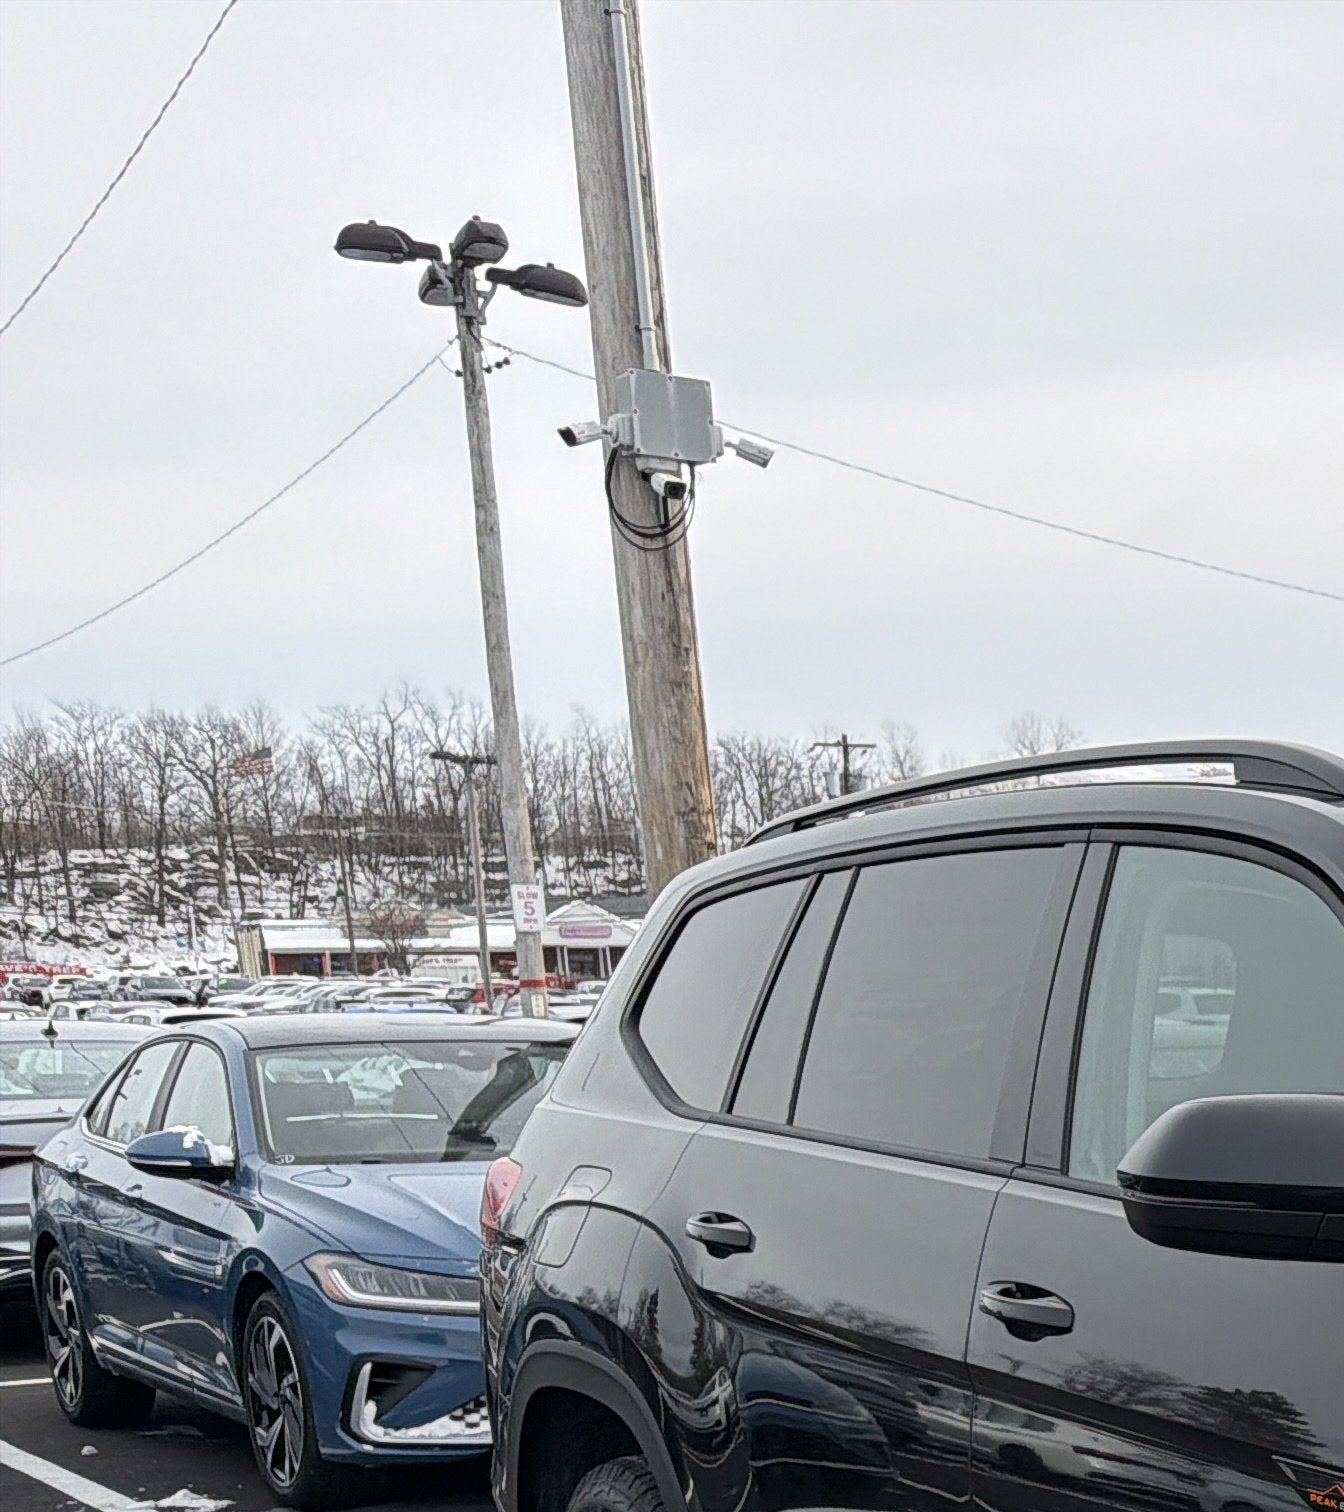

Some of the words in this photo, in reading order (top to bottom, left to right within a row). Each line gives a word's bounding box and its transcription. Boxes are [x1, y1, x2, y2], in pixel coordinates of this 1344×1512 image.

[516, 891, 538, 900] SLOW
[523, 901, 536, 916] 5
[1309, 1493, 1338, 1510] PEAK
